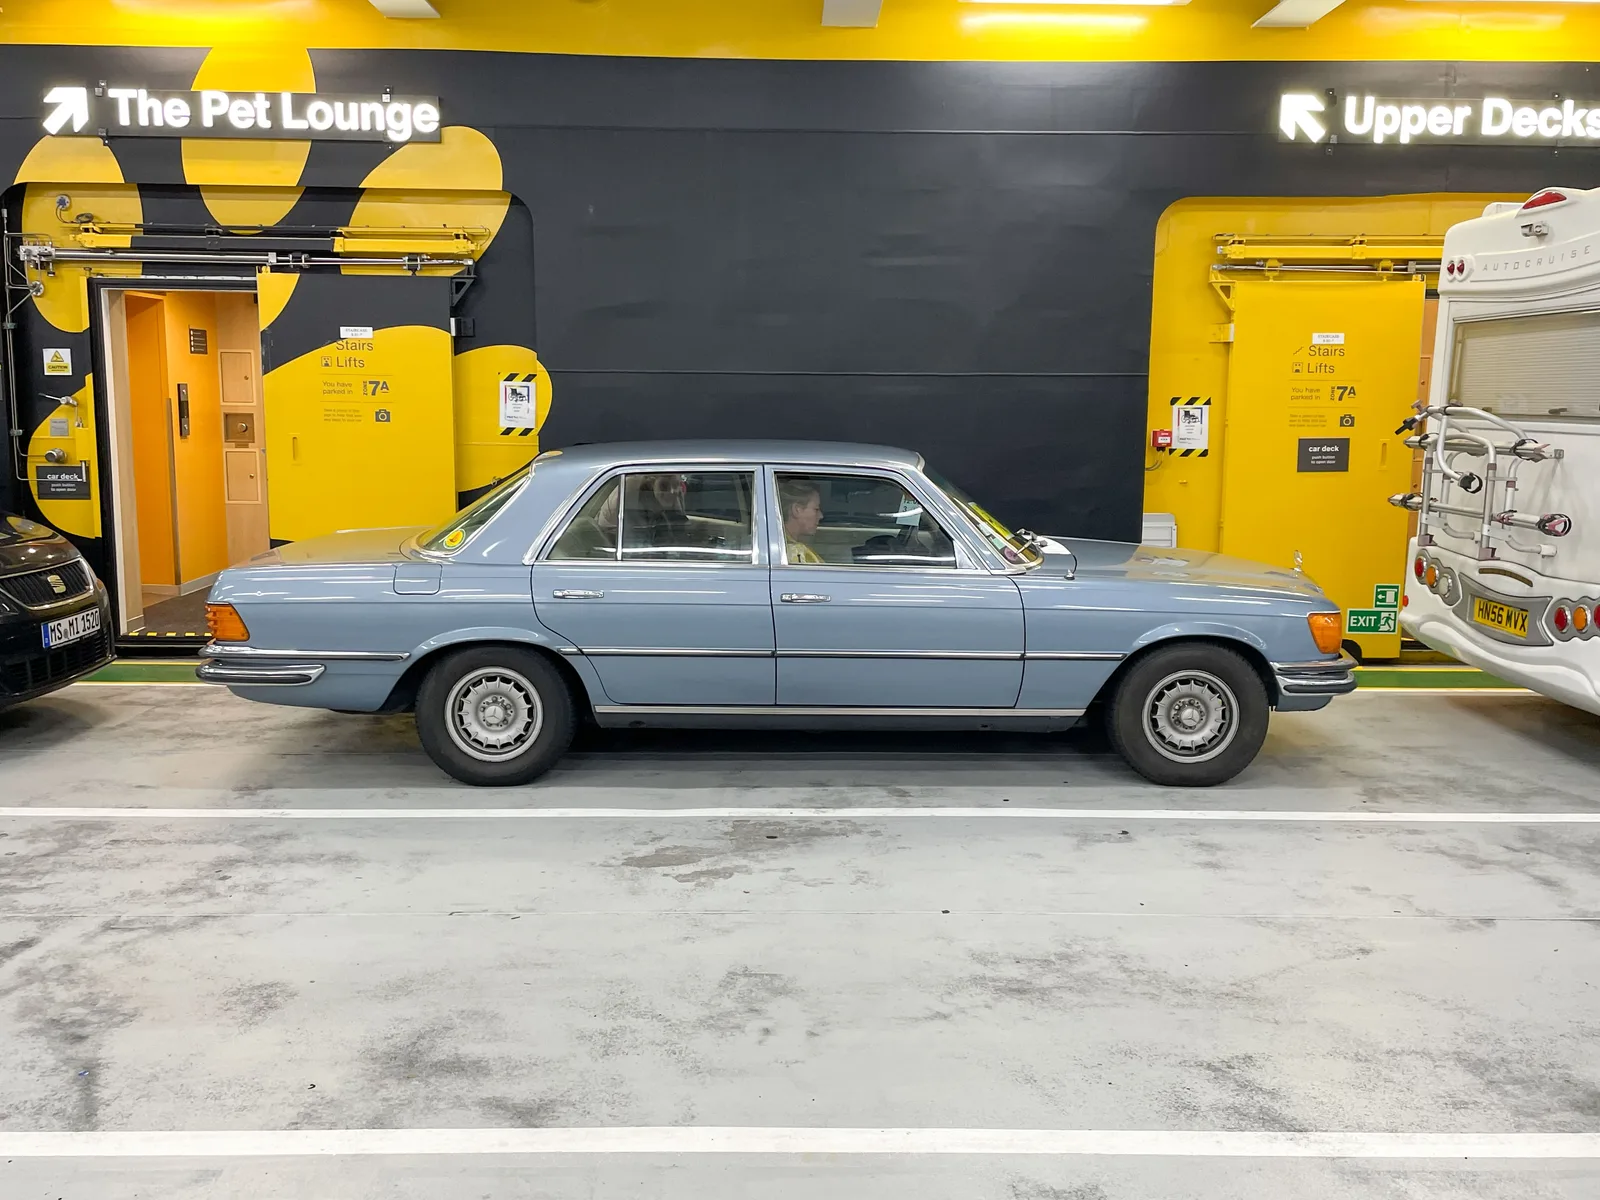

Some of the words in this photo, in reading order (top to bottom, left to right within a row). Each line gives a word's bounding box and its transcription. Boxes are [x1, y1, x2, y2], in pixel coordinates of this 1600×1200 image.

[108, 88, 191, 127] The
[199, 90, 271, 129] Pet
[281, 92, 440, 141] Lounge
[1344, 95, 1471, 144] Upper
[1482, 245, 1591, 272] AUTOCRUISE
[336, 340, 374, 351] Stairs
[1308, 345, 1345, 357] Stairs
[336, 356, 365, 368] Lifts
[1307, 362, 1335, 374] Lifts
[1350, 615, 1377, 627] EXIT
[1477, 600, 1504, 625] HN56
[1505, 609, 1528, 633] MVX
[50, 622, 63, 643] MS
[68, 617, 80, 637] MI
[81, 610, 100, 633] 1520
